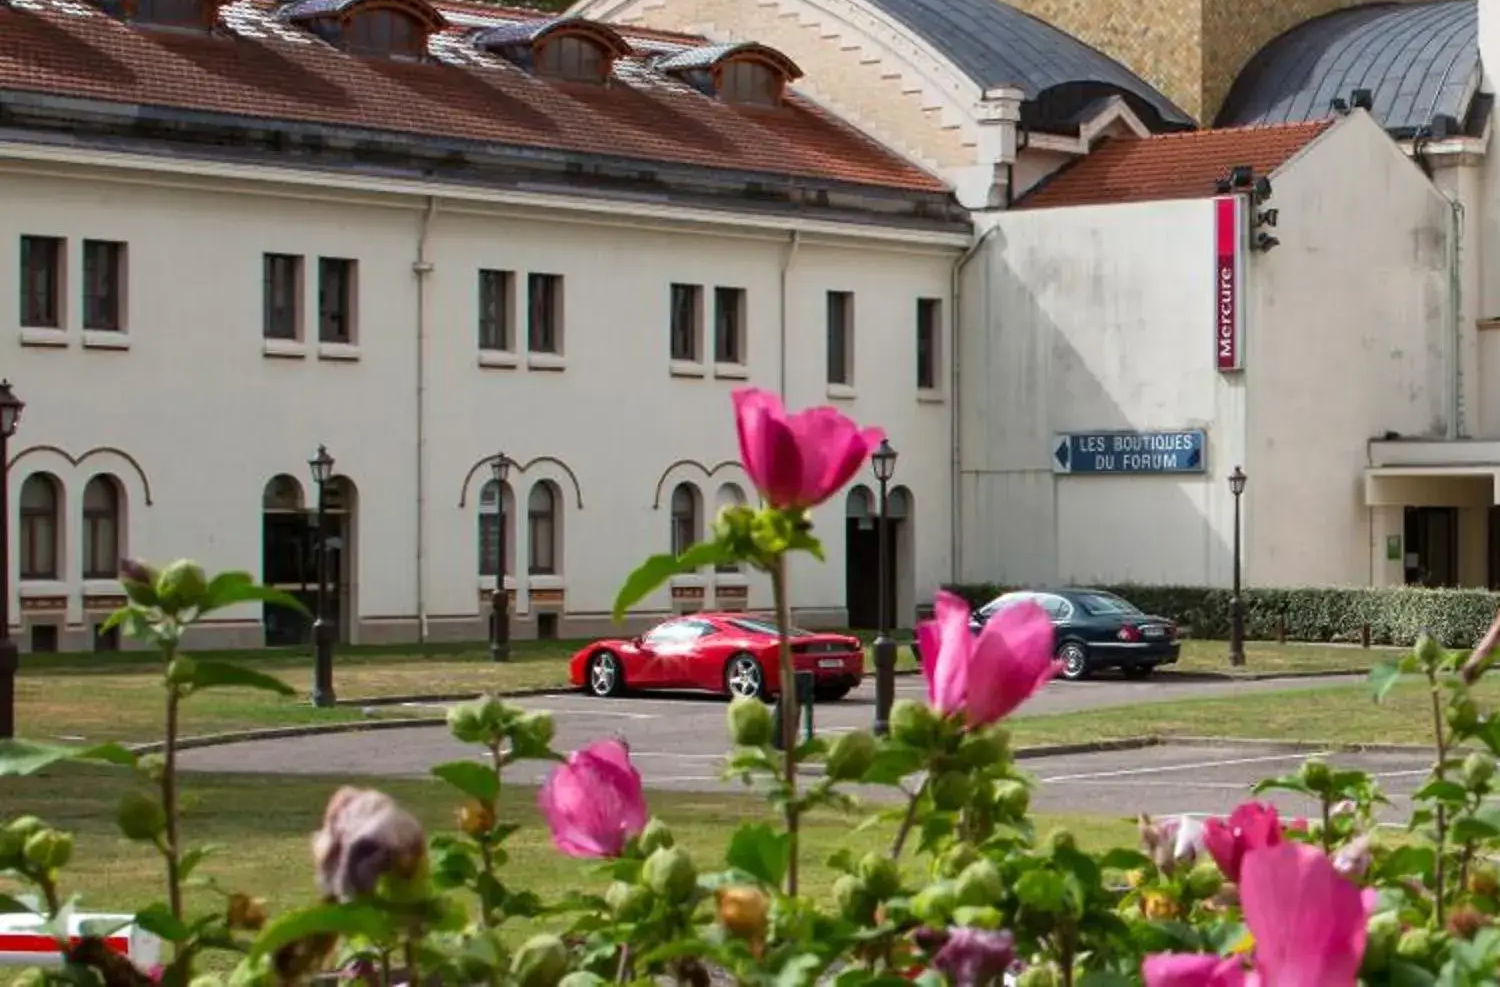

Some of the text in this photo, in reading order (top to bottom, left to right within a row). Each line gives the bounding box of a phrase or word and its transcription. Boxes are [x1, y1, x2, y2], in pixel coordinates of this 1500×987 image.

[1219, 267, 1233, 357] Mercure
[1079, 435, 1193, 452] LES BOUTIQUES
[1095, 454, 1177, 470] DU FORUM
